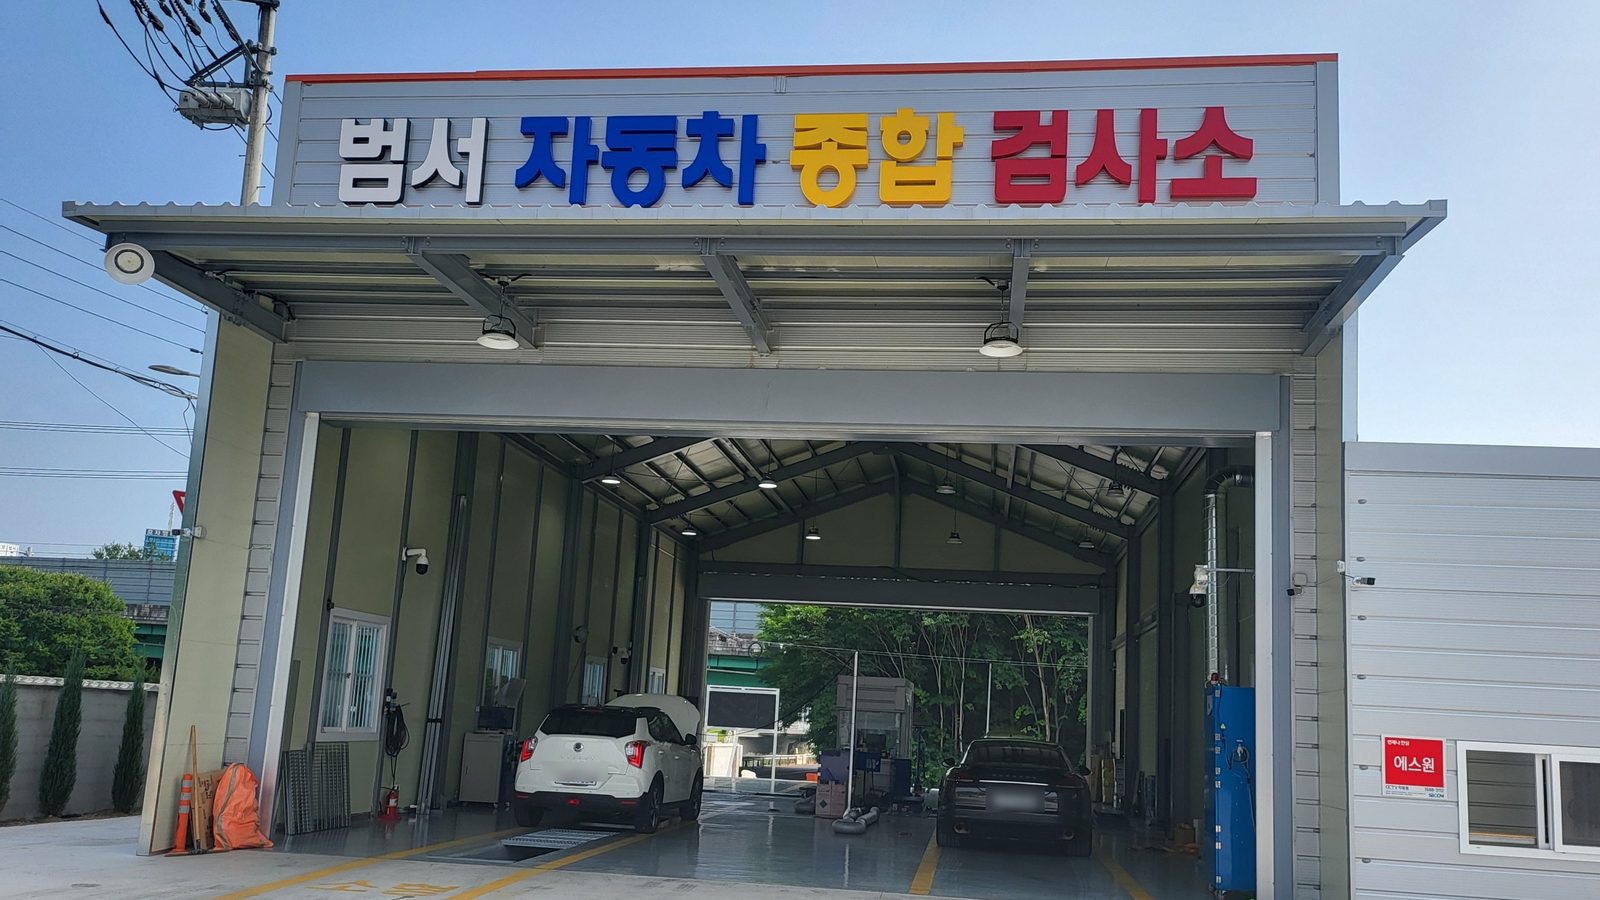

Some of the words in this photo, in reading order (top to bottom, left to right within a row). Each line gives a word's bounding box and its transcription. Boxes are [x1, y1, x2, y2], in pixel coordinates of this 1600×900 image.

[338, 117, 489, 205] 범서
[515, 111, 766, 208] 자동차
[790, 108, 964, 207] 종합
[991, 106, 1257, 204] 검사소
[1393, 755, 1435, 773] 에스원
